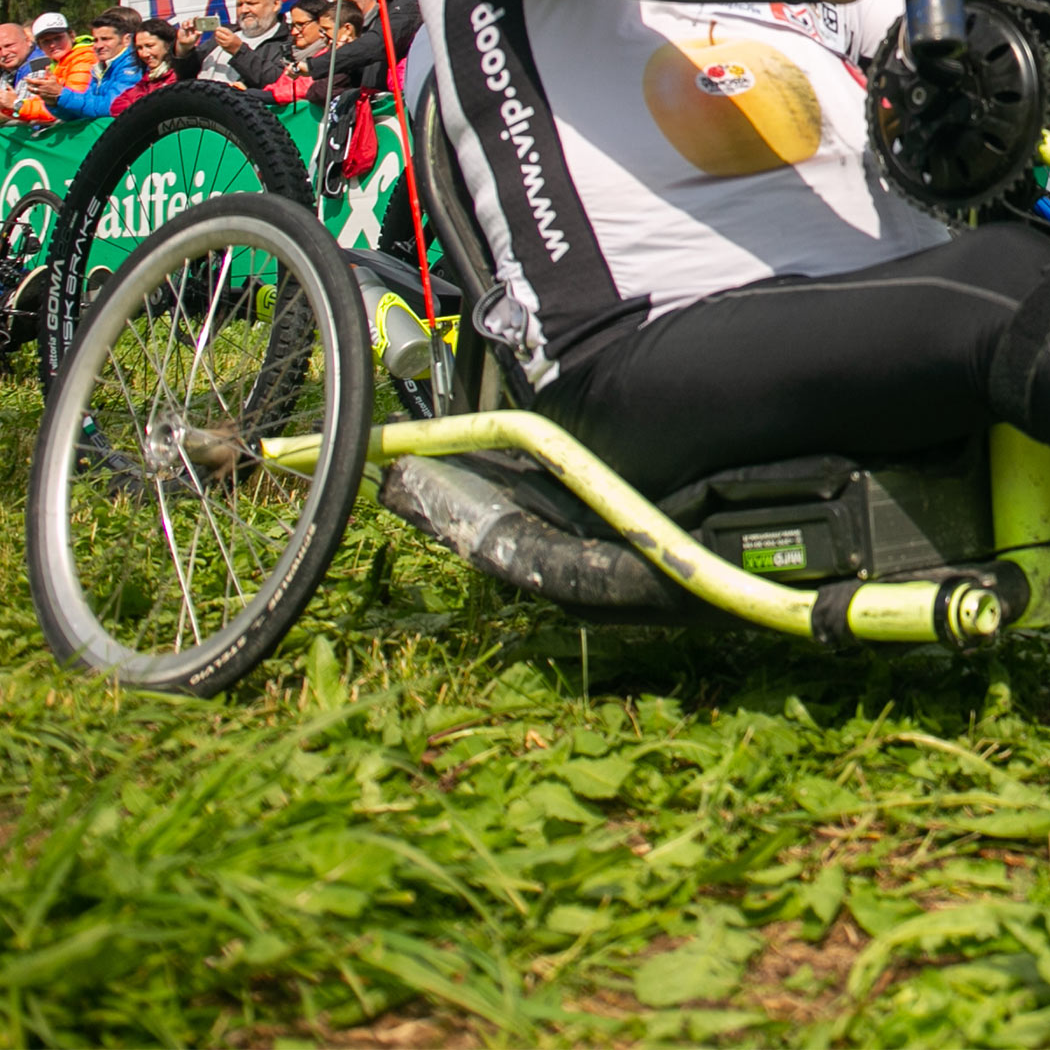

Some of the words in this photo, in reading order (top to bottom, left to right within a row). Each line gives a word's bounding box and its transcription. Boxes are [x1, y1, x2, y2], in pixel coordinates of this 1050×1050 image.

[470, 2, 570, 263] www.vip.coop
[65, 169, 264, 239] aiffei
[65, 196, 102, 296] BRAKE
[46, 259, 65, 331] GOMA
[49, 336, 58, 370] vittoria
[269, 523, 316, 610] SCHWALBE
[190, 637, 247, 685] STELVIO
